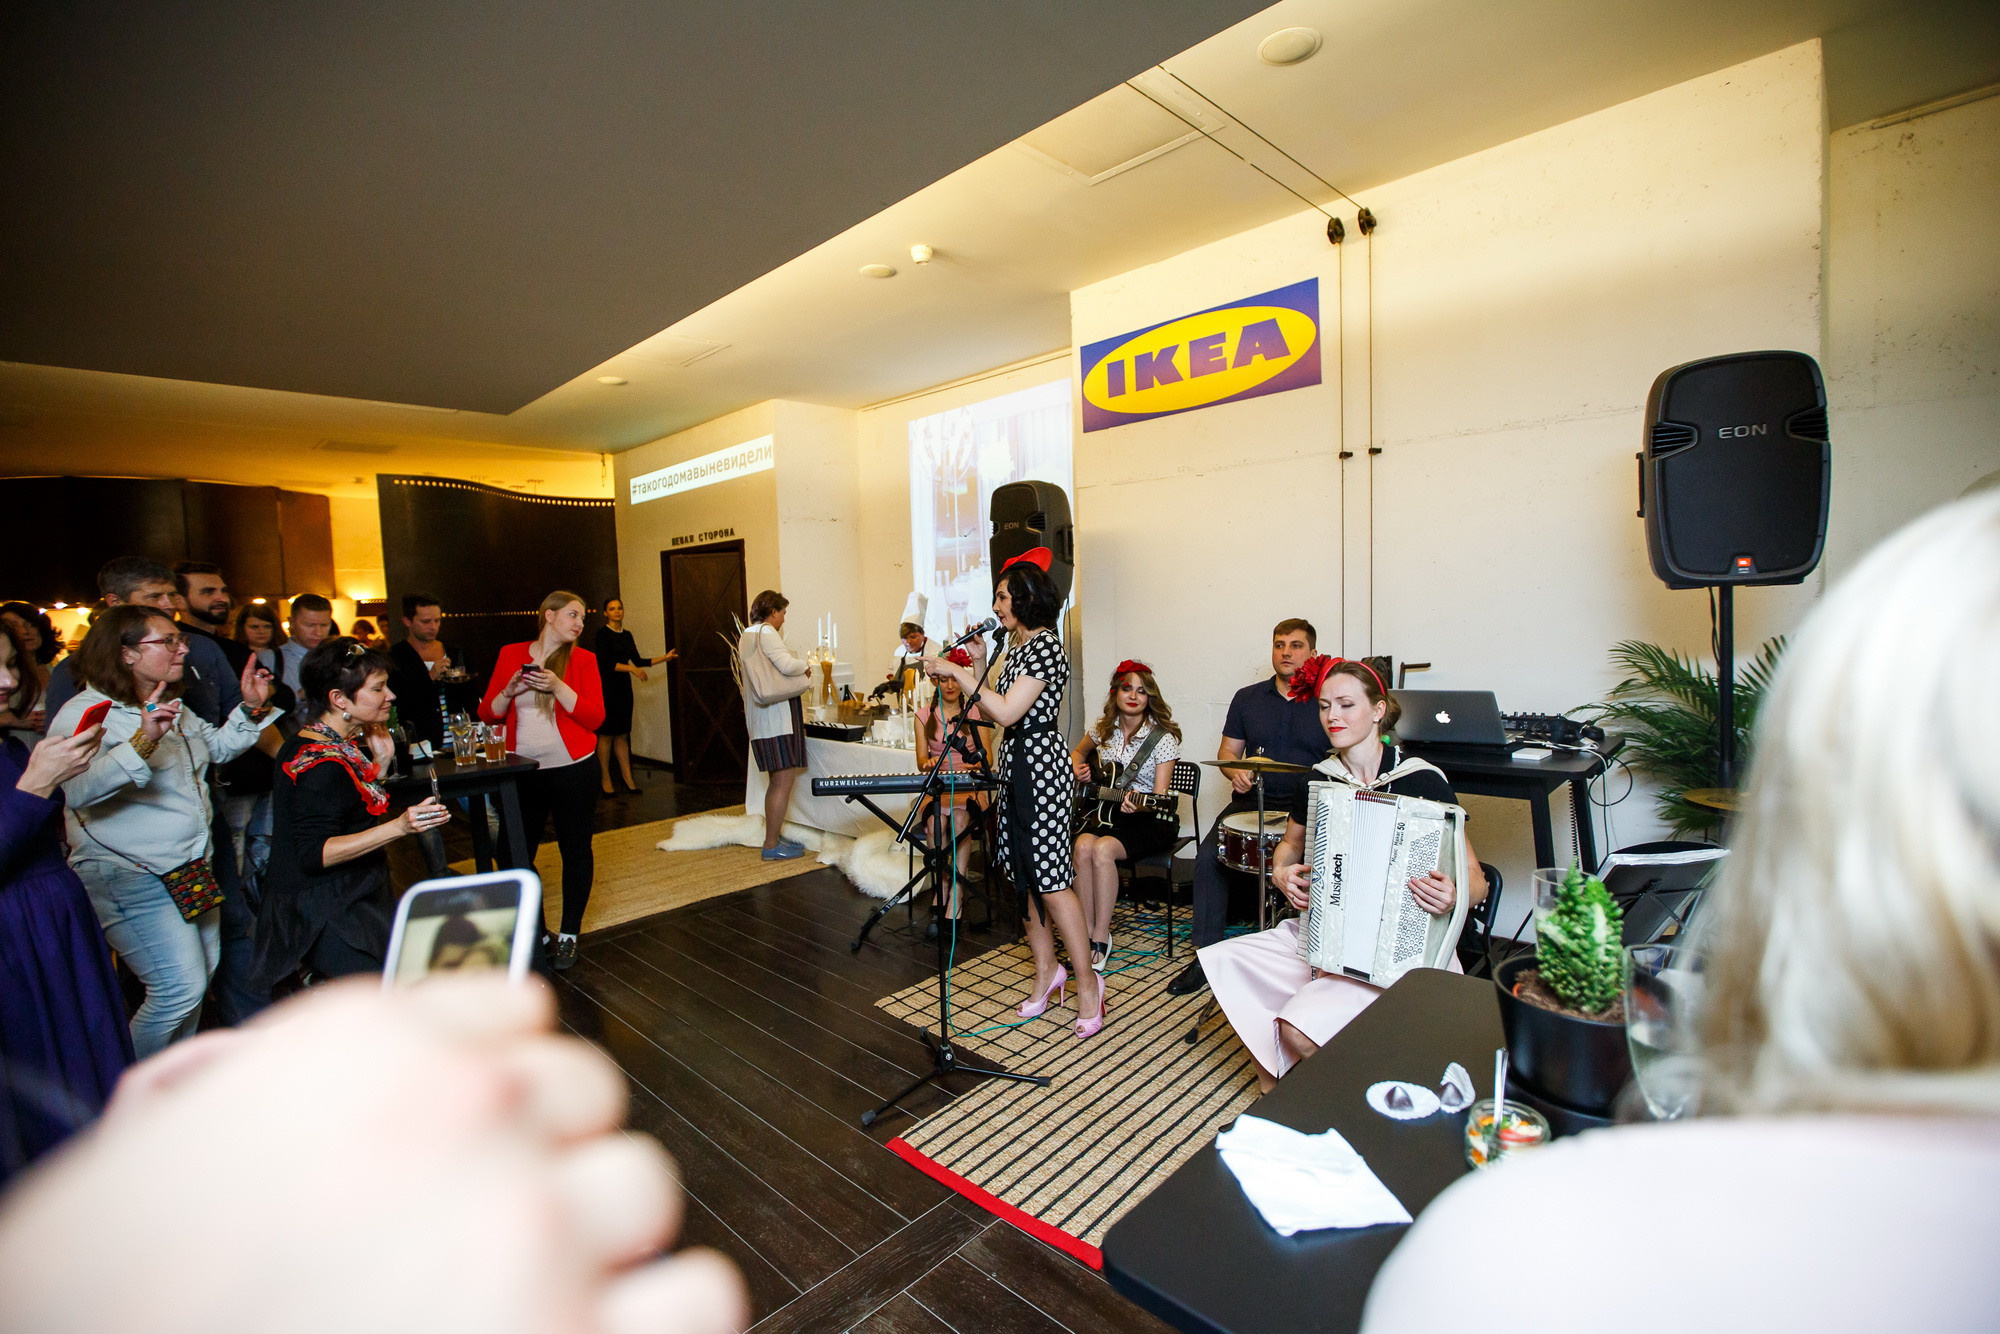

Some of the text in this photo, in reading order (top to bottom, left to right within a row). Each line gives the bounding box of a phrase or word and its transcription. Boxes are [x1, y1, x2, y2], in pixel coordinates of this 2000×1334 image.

[1106, 317, 1292, 399] IKEA
[1718, 423, 1767, 439] EON
[631, 444, 773, 496] #такогодомавыневидели
[1004, 521, 1020, 530] EON
[698, 528, 736, 542] СТОРОНА
[1396, 821, 1406, 831] 50
